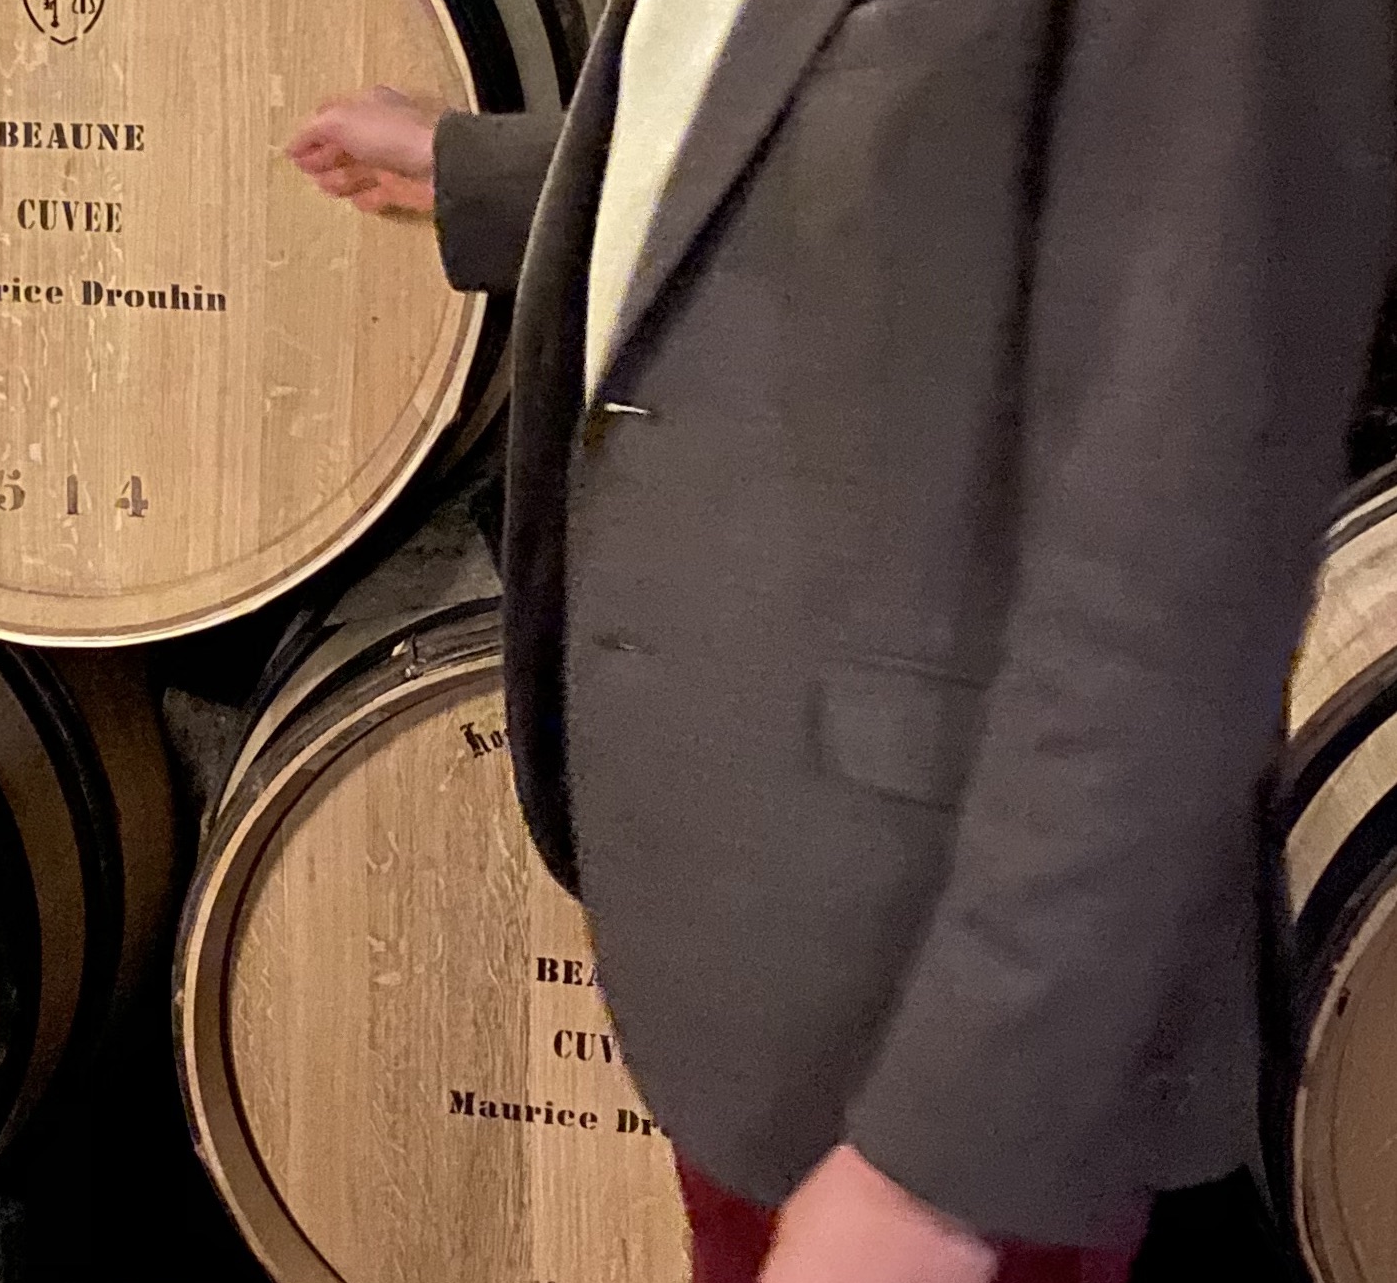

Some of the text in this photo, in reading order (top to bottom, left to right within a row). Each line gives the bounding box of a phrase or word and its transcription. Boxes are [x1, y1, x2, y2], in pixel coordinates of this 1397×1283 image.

[16, 198, 123, 234] CUVEE
[81, 279, 228, 313] Drouhin
[449, 1089, 598, 1131] Maurice
